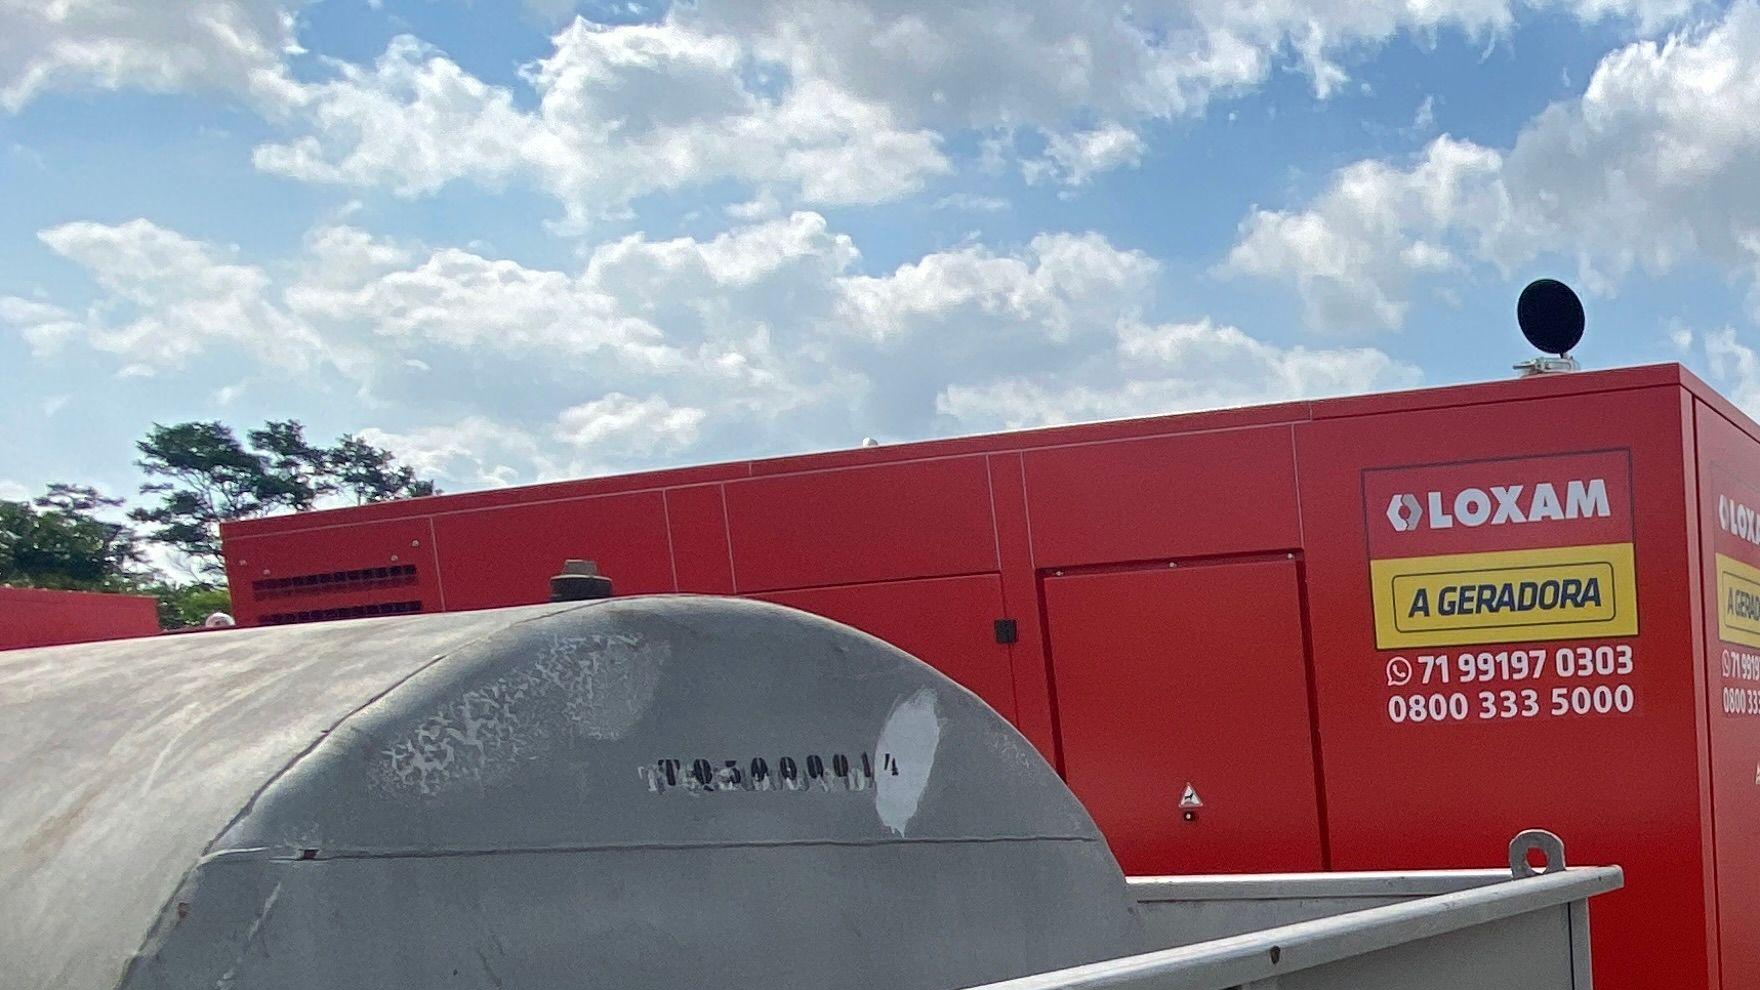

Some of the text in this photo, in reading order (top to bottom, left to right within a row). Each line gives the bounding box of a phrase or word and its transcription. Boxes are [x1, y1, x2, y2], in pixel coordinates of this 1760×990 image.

[1427, 479, 1611, 529] LOXAM
[1408, 577, 1602, 618] A GERADORA
[1417, 645, 1634, 684] 71 99197 0303
[1730, 651, 1741, 678] 71
[1388, 684, 1634, 722] 0800 333 5000
[1723, 686, 1747, 714] 0800
